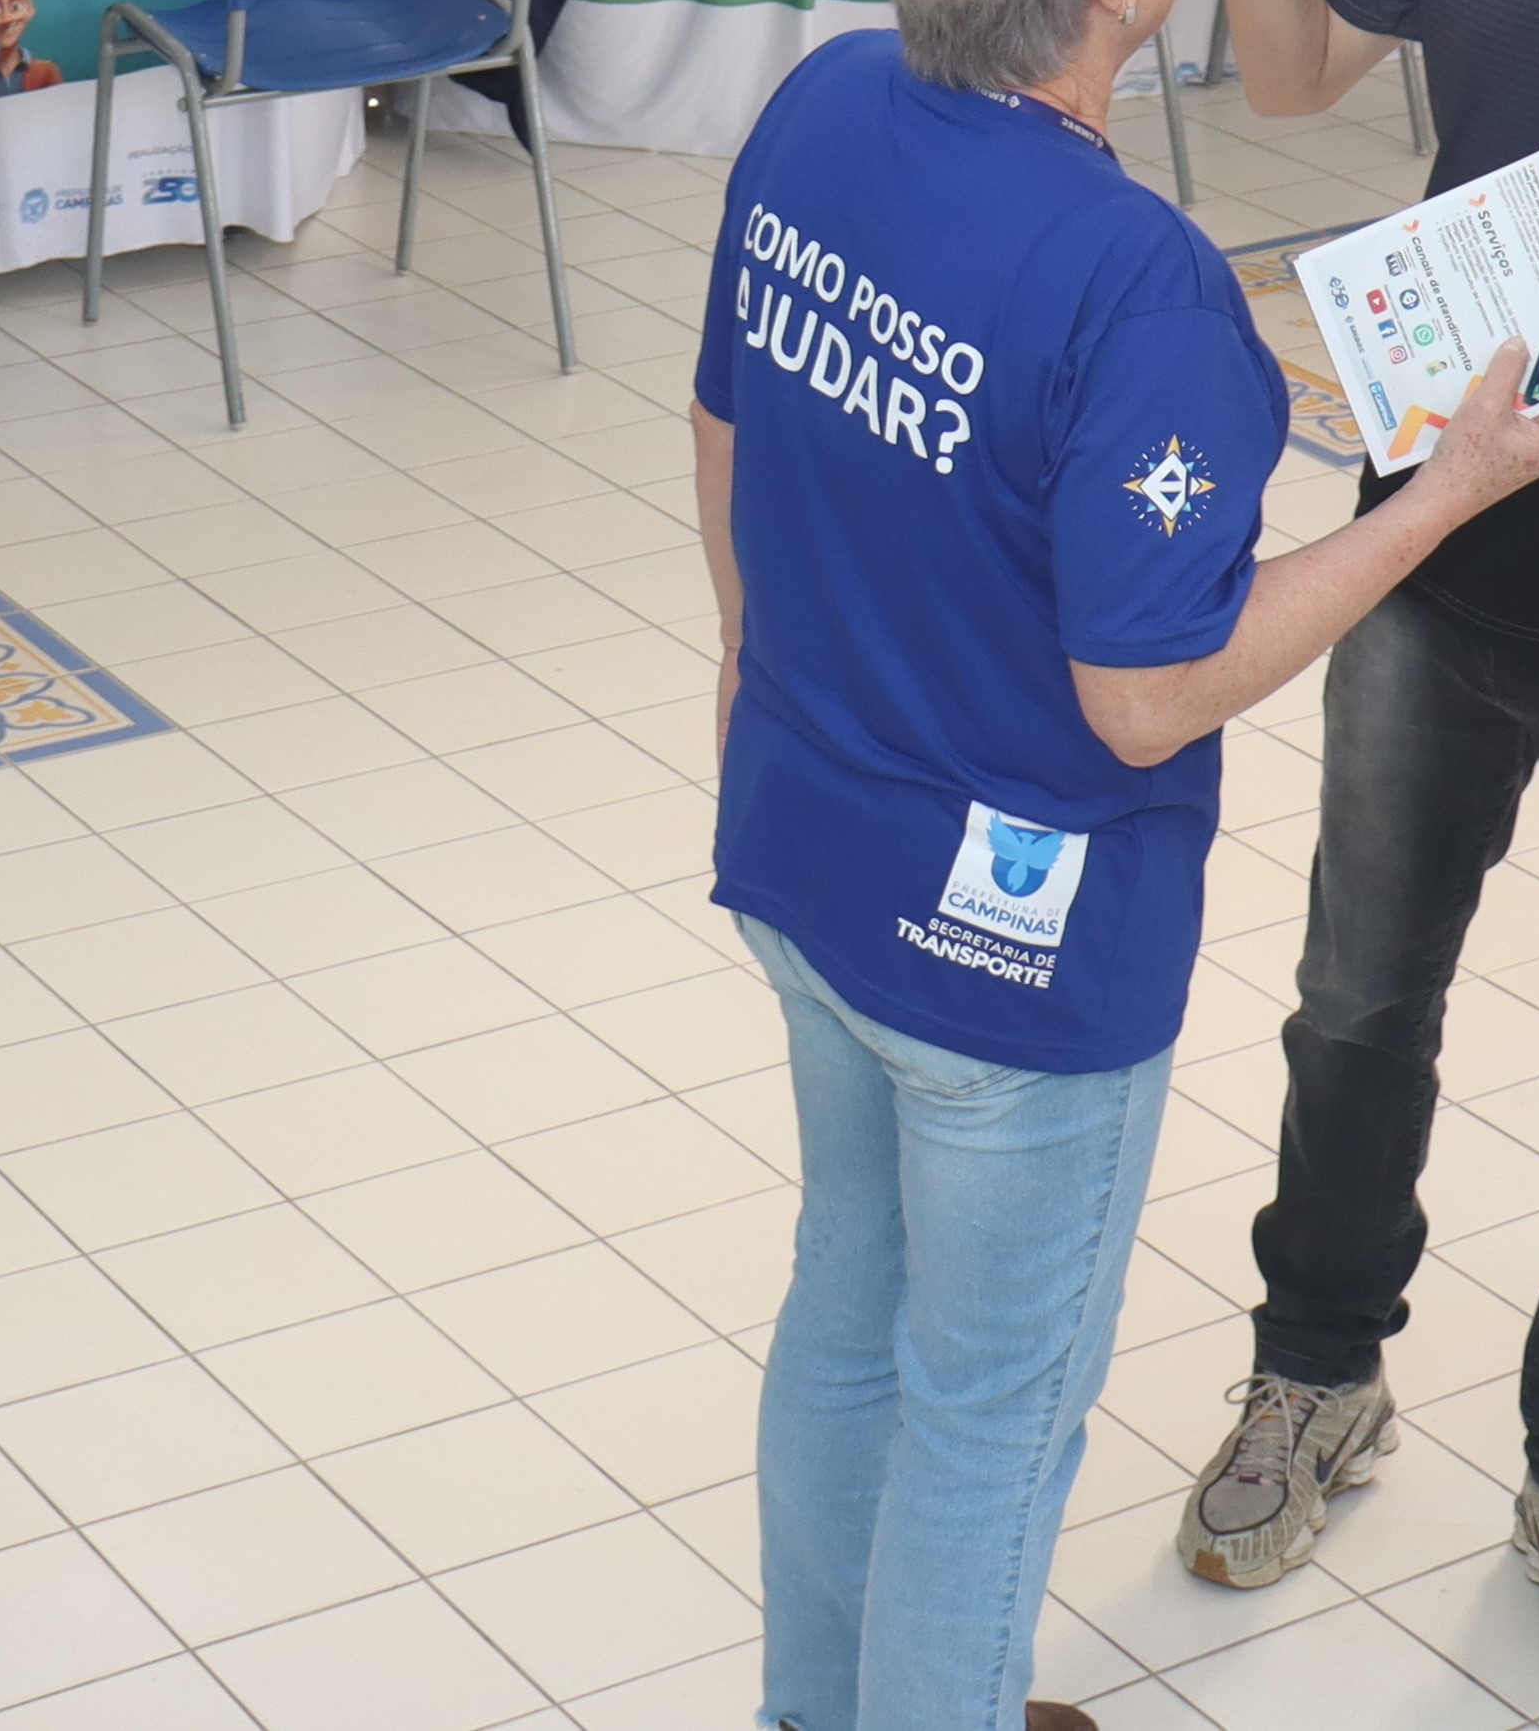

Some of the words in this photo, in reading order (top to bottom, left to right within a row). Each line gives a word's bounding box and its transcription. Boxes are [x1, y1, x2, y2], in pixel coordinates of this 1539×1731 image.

[1061, 116, 1096, 143] EMDEC
[1476, 209, 1515, 278] Serviços
[743, 202, 845, 303] COMO
[848, 274, 985, 395] POSSO
[1410, 235, 1435, 278] Canais
[1428, 277, 1442, 294] de
[1436, 295, 1474, 373] atendimento
[947, 891, 1060, 936] CAMPINAS
[952, 880, 1040, 918] PREFEITURA
[1047, 906, 1062, 919] DE
[896, 916, 1054, 990] TRANSPORTE
[928, 917, 1031, 964] SECRETARIA
[1034, 951, 1057, 970] DE
